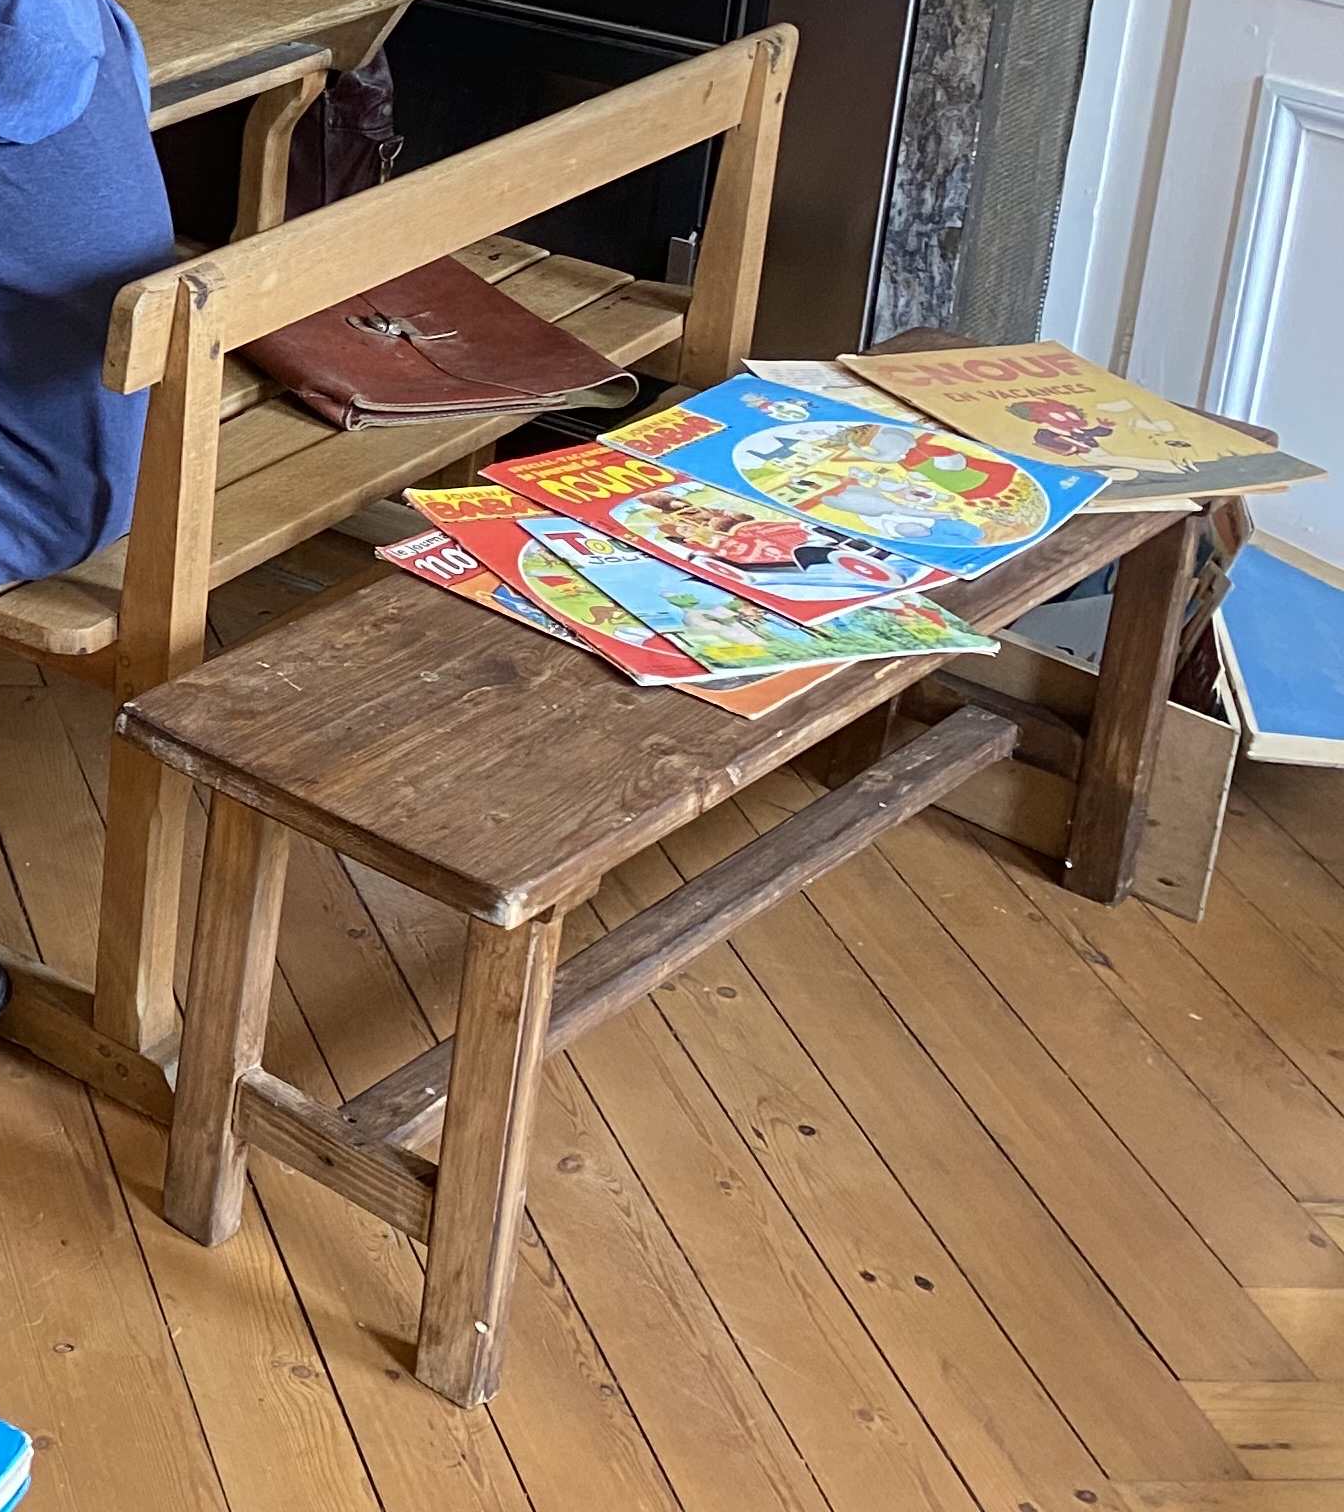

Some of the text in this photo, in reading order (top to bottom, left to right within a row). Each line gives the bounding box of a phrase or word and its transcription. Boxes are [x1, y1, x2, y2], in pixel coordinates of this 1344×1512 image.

[944, 383, 1097, 403] EN VACANCES
[624, 416, 723, 456] BABAR
[417, 495, 437, 504] LE
